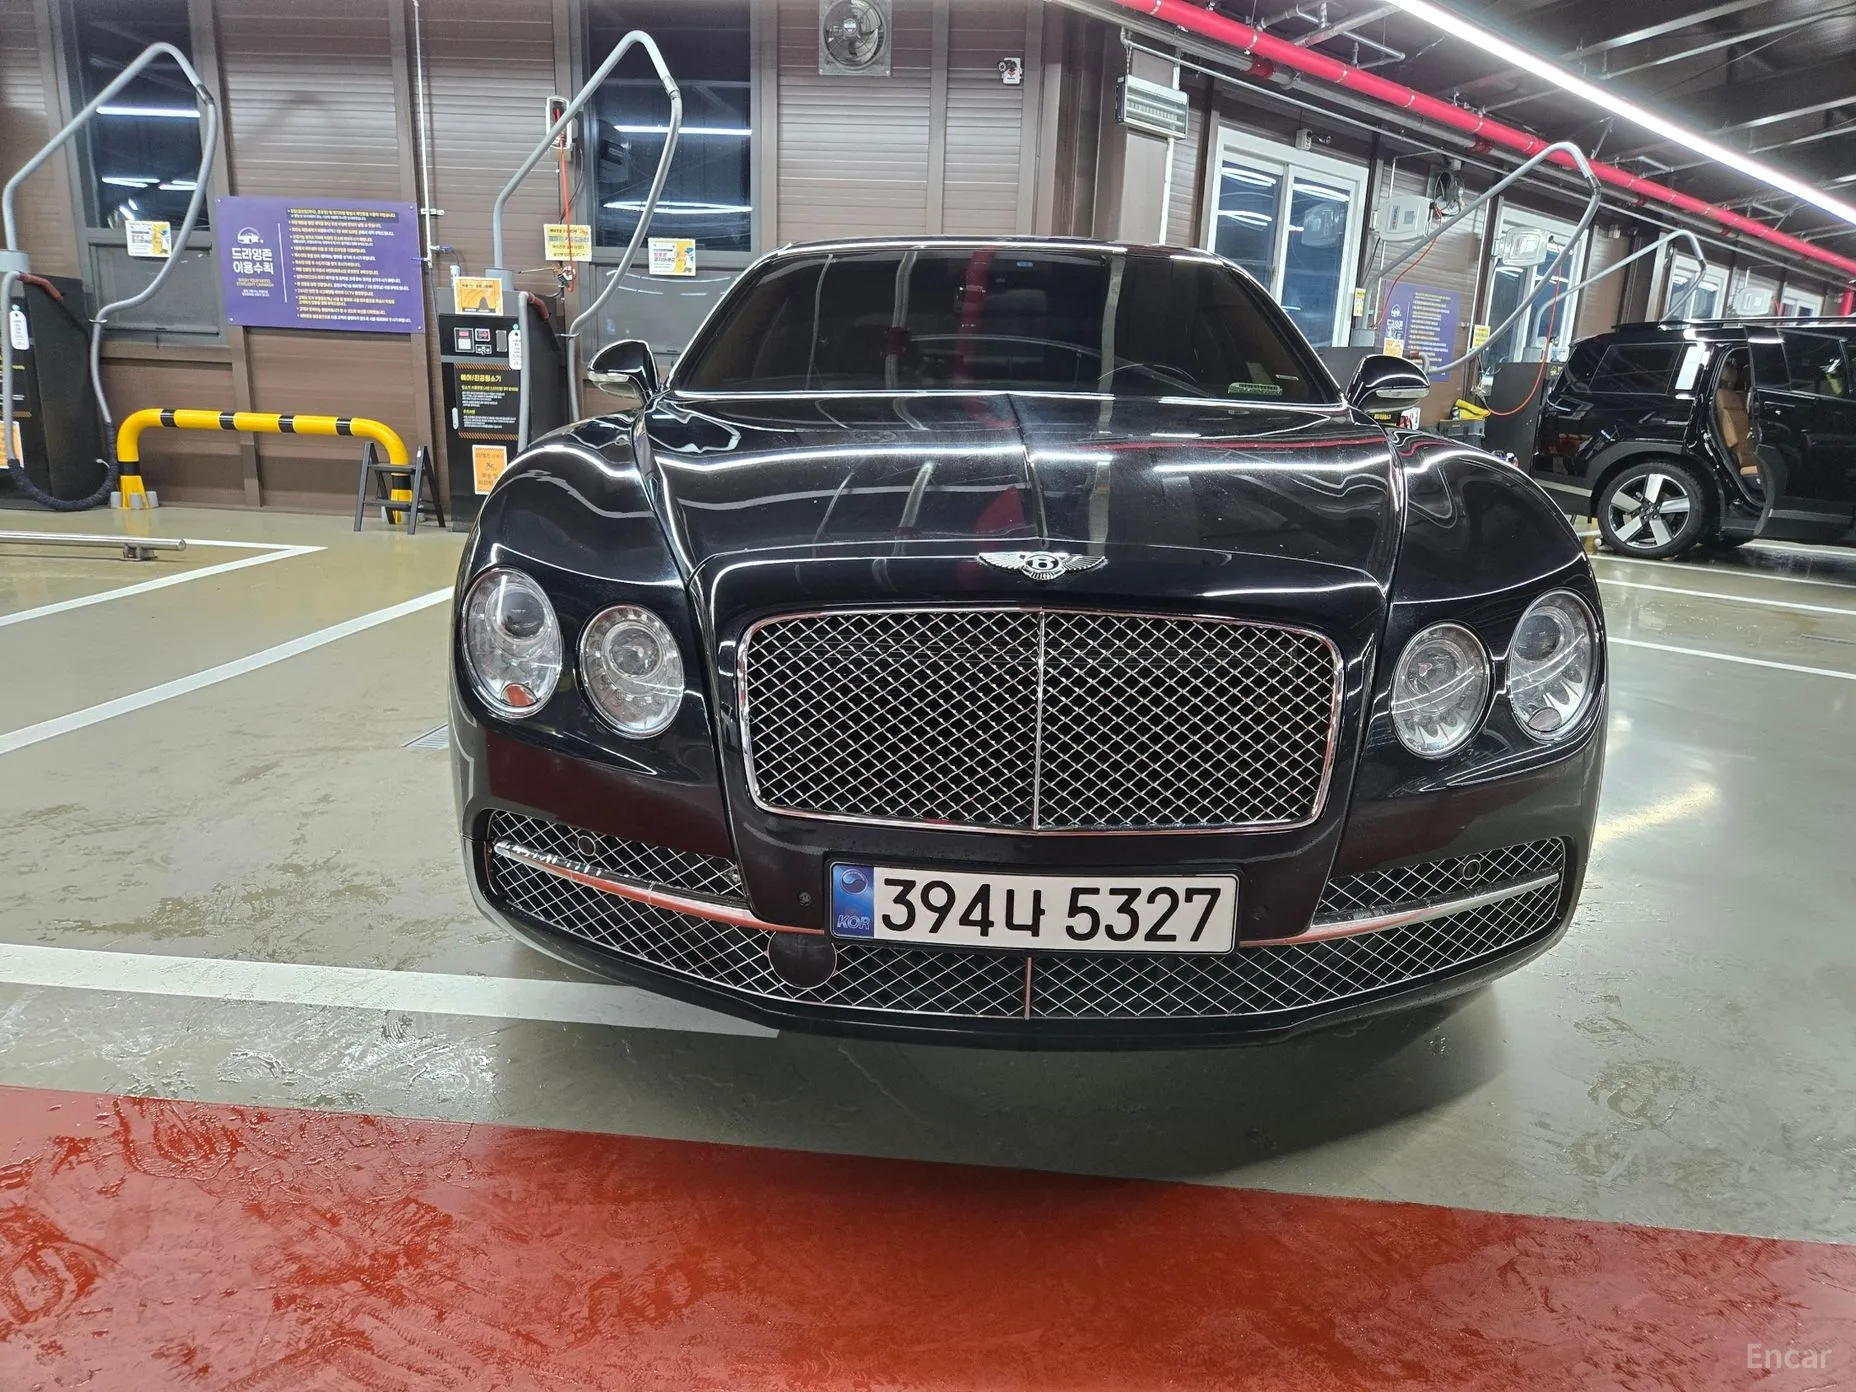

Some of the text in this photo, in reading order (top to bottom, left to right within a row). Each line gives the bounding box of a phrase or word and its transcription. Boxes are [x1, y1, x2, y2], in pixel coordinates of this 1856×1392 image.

[231, 247, 273, 261] 드라잉존
[232, 261, 274, 275] 이용수칙
[881, 878, 1222, 942] 394나 5327
[837, 914, 871, 931] KOR
